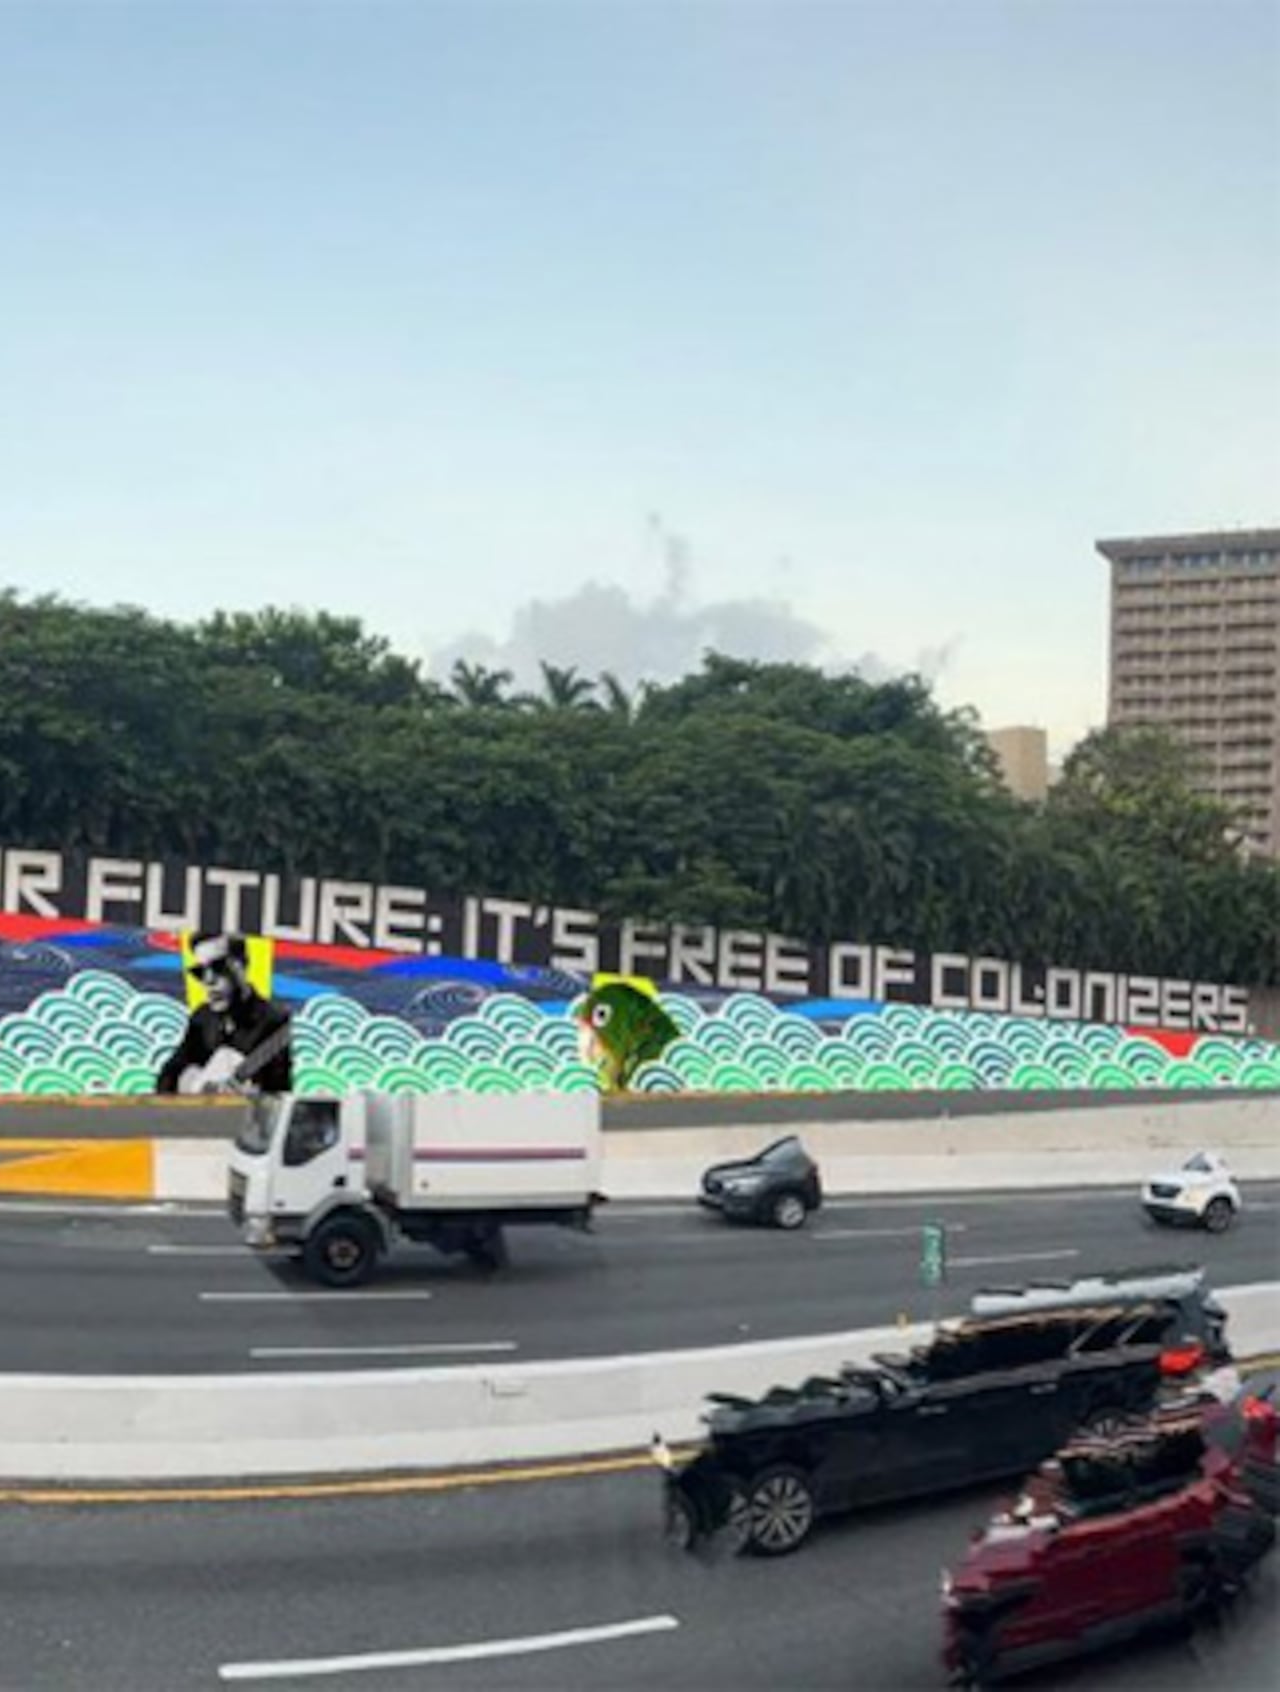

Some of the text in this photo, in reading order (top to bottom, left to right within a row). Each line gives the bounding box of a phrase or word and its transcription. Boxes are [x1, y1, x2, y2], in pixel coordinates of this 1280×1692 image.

[86, 857, 441, 956] FUTURE:
[463, 897, 599, 973] IT'S
[621, 918, 809, 995] FREE
[830, 942, 915, 1000] OF
